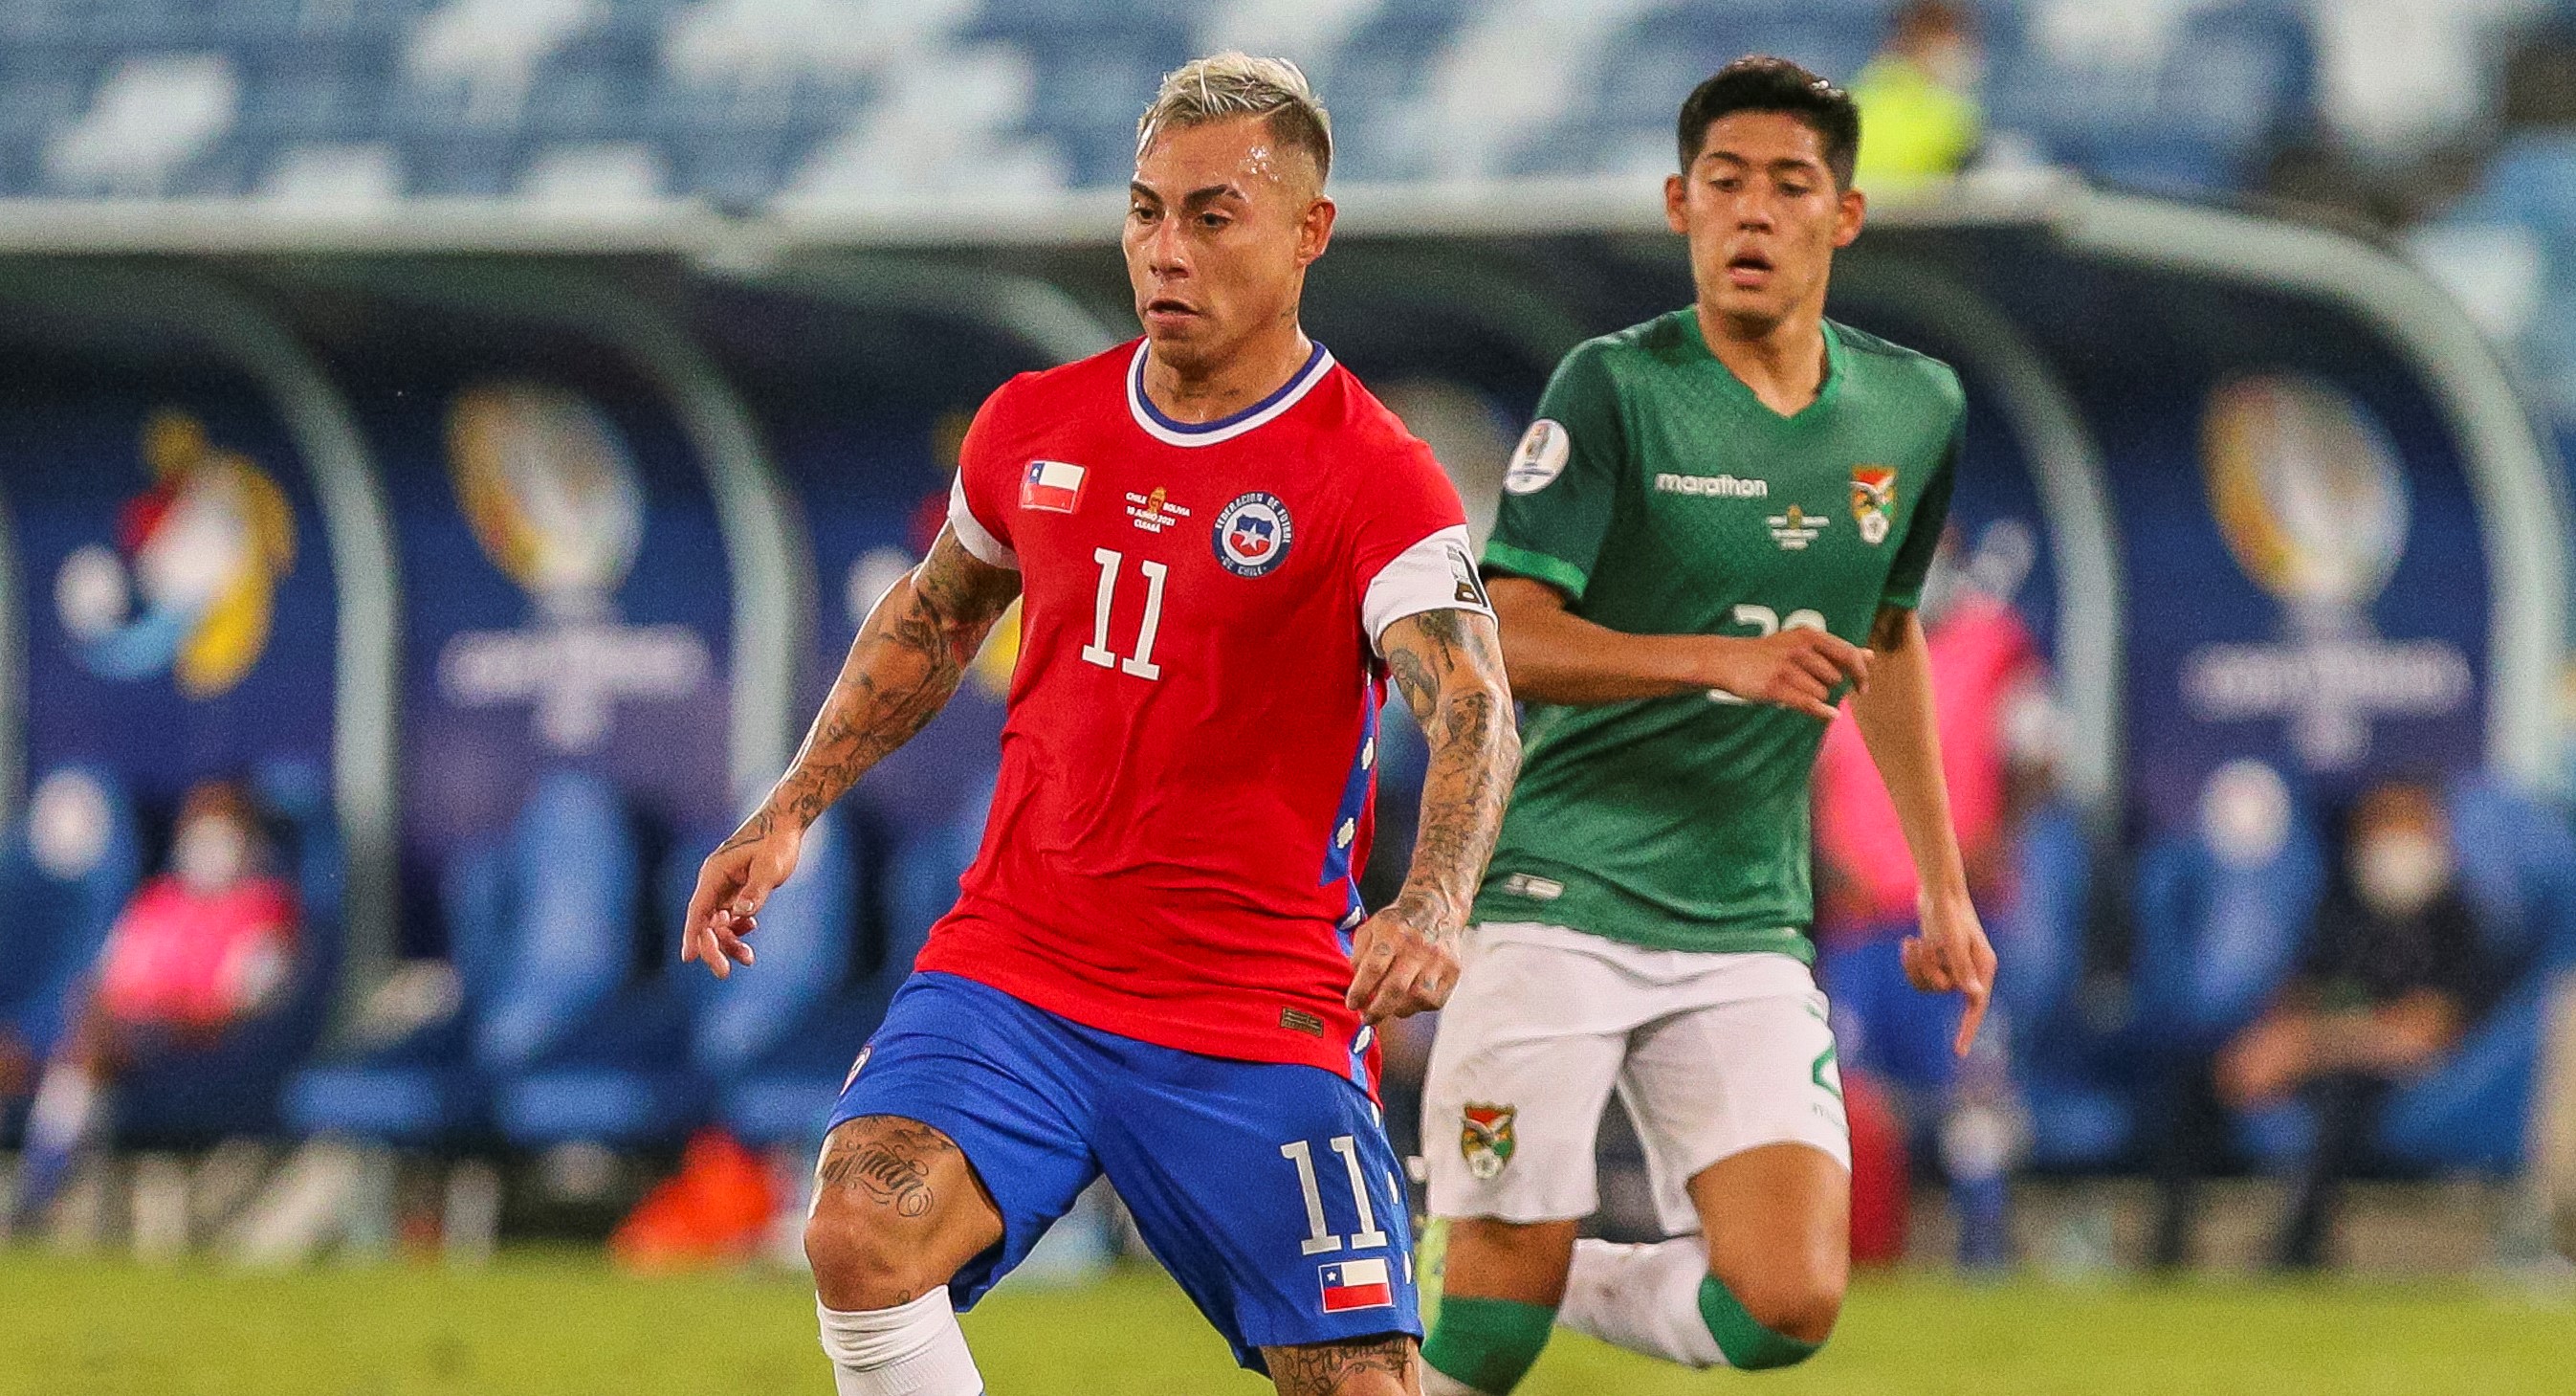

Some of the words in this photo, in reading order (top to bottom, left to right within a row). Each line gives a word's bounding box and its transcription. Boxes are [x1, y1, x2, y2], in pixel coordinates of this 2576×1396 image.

[1655, 473, 1769, 498] marathon
[1162, 502, 1191, 517] BOLIVIA
[1266, 496, 1280, 510] DE
[1081, 546, 1168, 681] 11
[1280, 1135, 1388, 1256] 11
